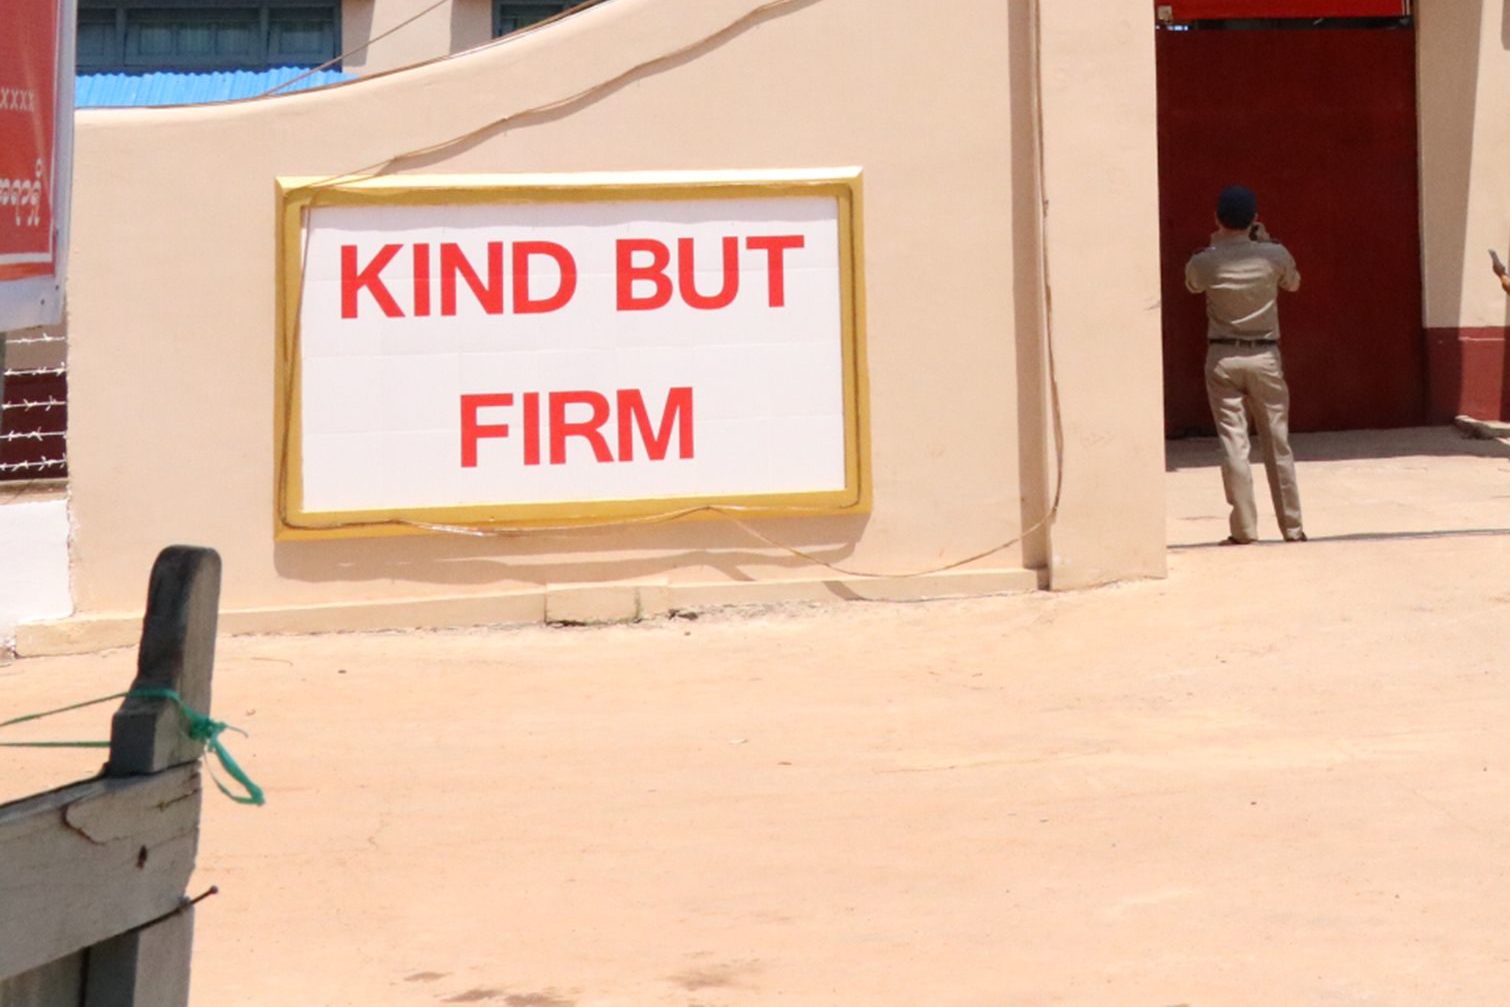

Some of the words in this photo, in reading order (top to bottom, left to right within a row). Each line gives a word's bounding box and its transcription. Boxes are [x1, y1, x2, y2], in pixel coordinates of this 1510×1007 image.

[340, 241, 577, 319] KIND
[615, 235, 805, 312] BUT
[460, 386, 695, 469] FIRM
